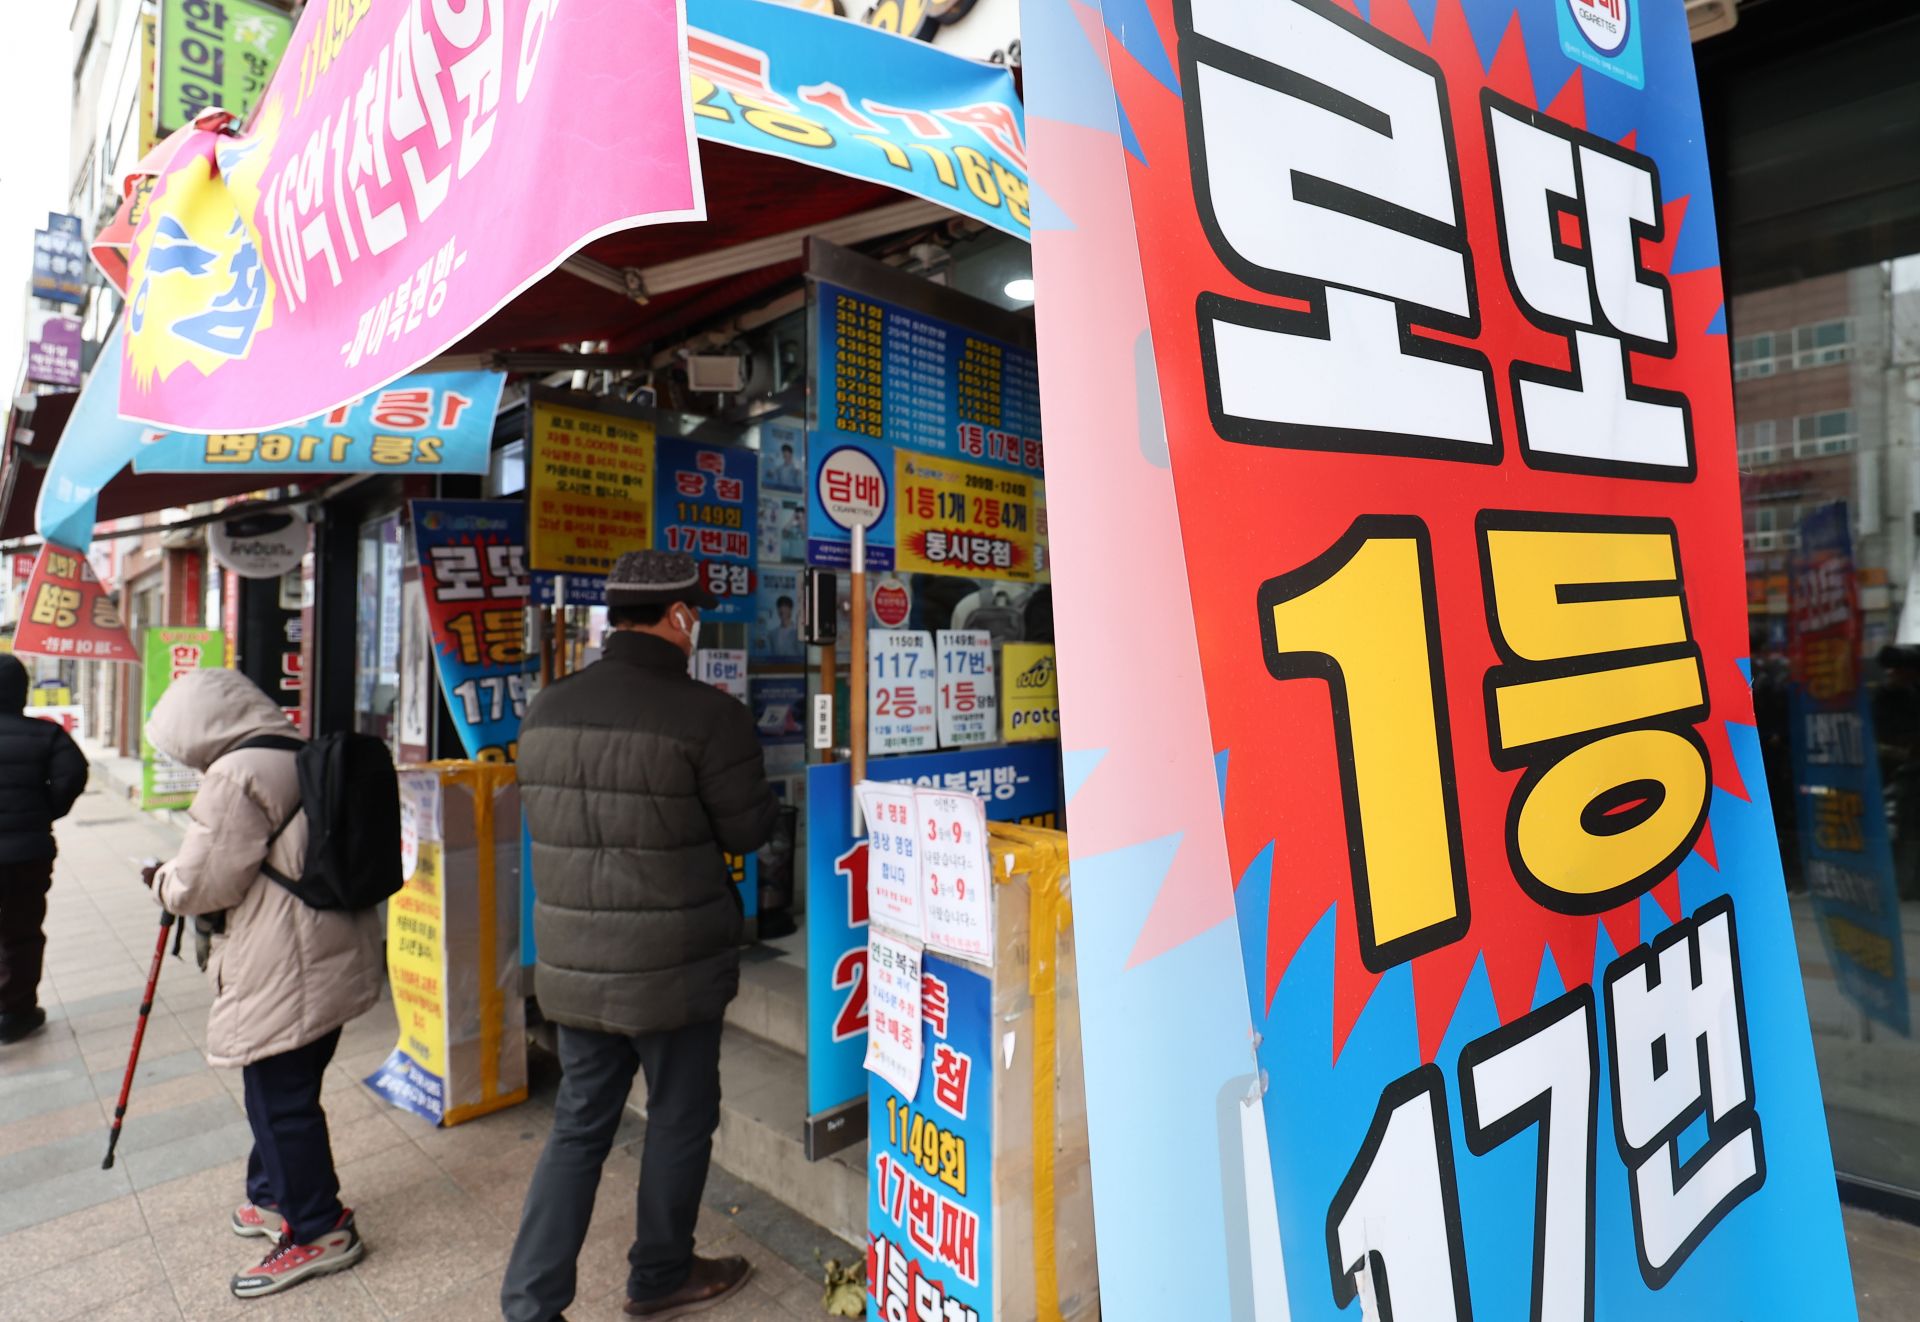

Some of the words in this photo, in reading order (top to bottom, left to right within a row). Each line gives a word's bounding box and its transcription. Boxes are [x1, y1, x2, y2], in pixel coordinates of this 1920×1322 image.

[1176, 0, 1697, 481] 로또
[957, 424, 983, 456] 1등
[988, 431, 1020, 464] 17번
[1024, 437, 1044, 469] 당
[826, 469, 880, 508] 담배
[678, 502, 742, 528] 1149회
[665, 526, 750, 558] 17번째
[925, 531, 1011, 568] 동시당첨
[430, 546, 530, 600] 로또
[707, 563, 750, 595] 당첨
[889, 635, 924, 648] 1150회
[943, 635, 976, 647] 1149회
[874, 652, 920, 678] 117
[944, 650, 985, 675] 17번
[876, 686, 917, 718] 2등
[941, 682, 976, 712] 1등
[1260, 512, 1711, 972] 1등
[873, 831, 890, 852] 정상
[896, 835, 913, 858] 영업
[870, 942, 919, 982] 연금복권
[1326, 895, 1766, 1322] 17번
[887, 1095, 967, 1197] 1149회
[875, 1151, 979, 1286] 17번째
